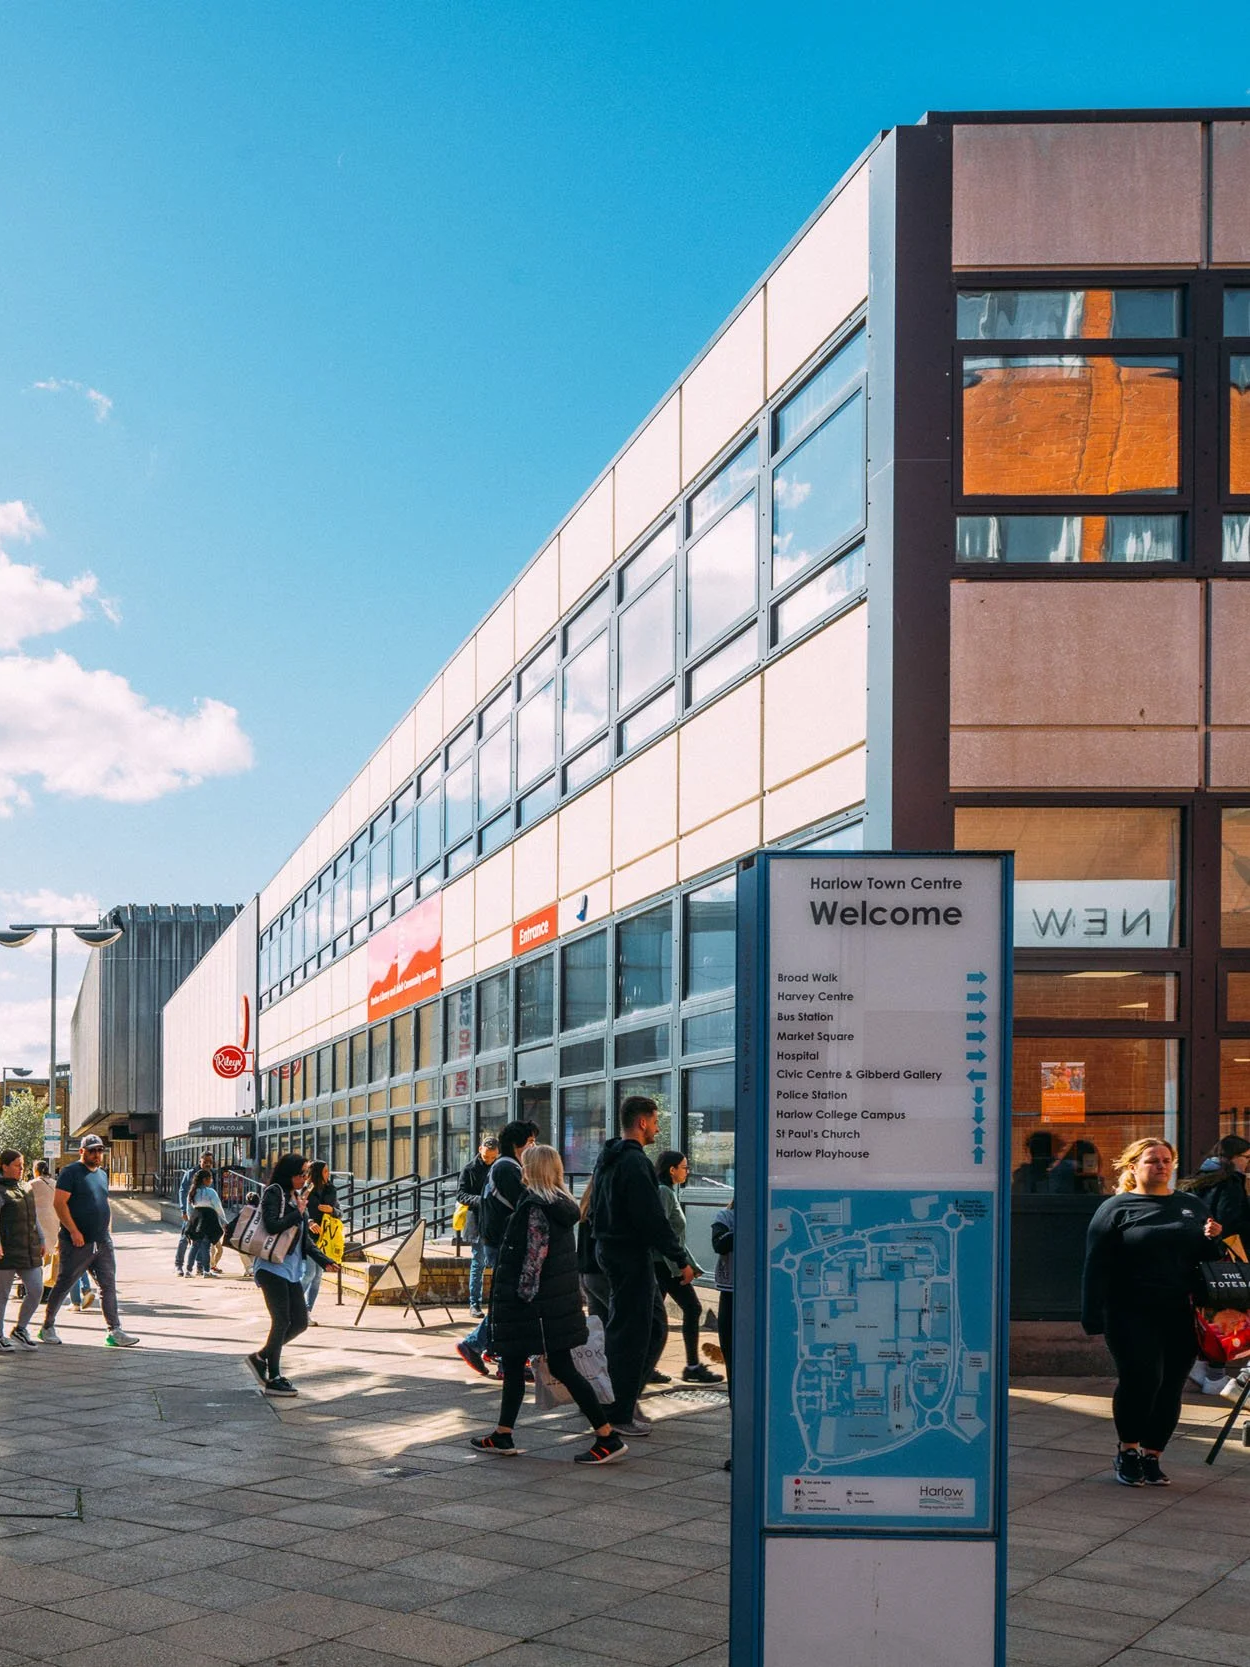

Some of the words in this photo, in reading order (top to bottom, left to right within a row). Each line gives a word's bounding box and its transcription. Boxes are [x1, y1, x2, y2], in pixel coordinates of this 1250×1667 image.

[810, 877, 864, 890] Harlow
[867, 877, 906, 890] Town
[910, 877, 963, 890] Centre
[809, 900, 963, 926] Welcome
[519, 919, 549, 946] Entrance
[777, 973, 809, 983] Broad
[812, 973, 838, 983] Walk
[777, 991, 815, 1003] Harvey
[818, 991, 854, 1001] Centre
[777, 1012, 796, 1022] Bus
[798, 1012, 834, 1022] Station
[777, 1032, 815, 1041] Market
[817, 1032, 854, 1043] Square
[214, 1053, 243, 1071] Rileys
[777, 1051, 819, 1062] Hospital
[777, 1069, 804, 1079] Civic
[806, 1069, 842, 1079] Centre
[845, 1070, 853, 1080] &
[855, 1070, 900, 1080] Gibberd
[903, 1070, 943, 1082] Gallery
[777, 1090, 809, 1100] Police
[812, 1090, 848, 1100] Station
[776, 1110, 813, 1119] Harlow
[816, 1110, 858, 1121] College
[861, 1110, 906, 1121] Campus
[776, 1129, 785, 1139] St
[788, 1129, 819, 1139] Paul's
[822, 1129, 860, 1139] Church
[776, 1149, 813, 1158] Harlow
[816, 1149, 870, 1160] Playhouse
[920, 1485, 963, 1497] Harlow
